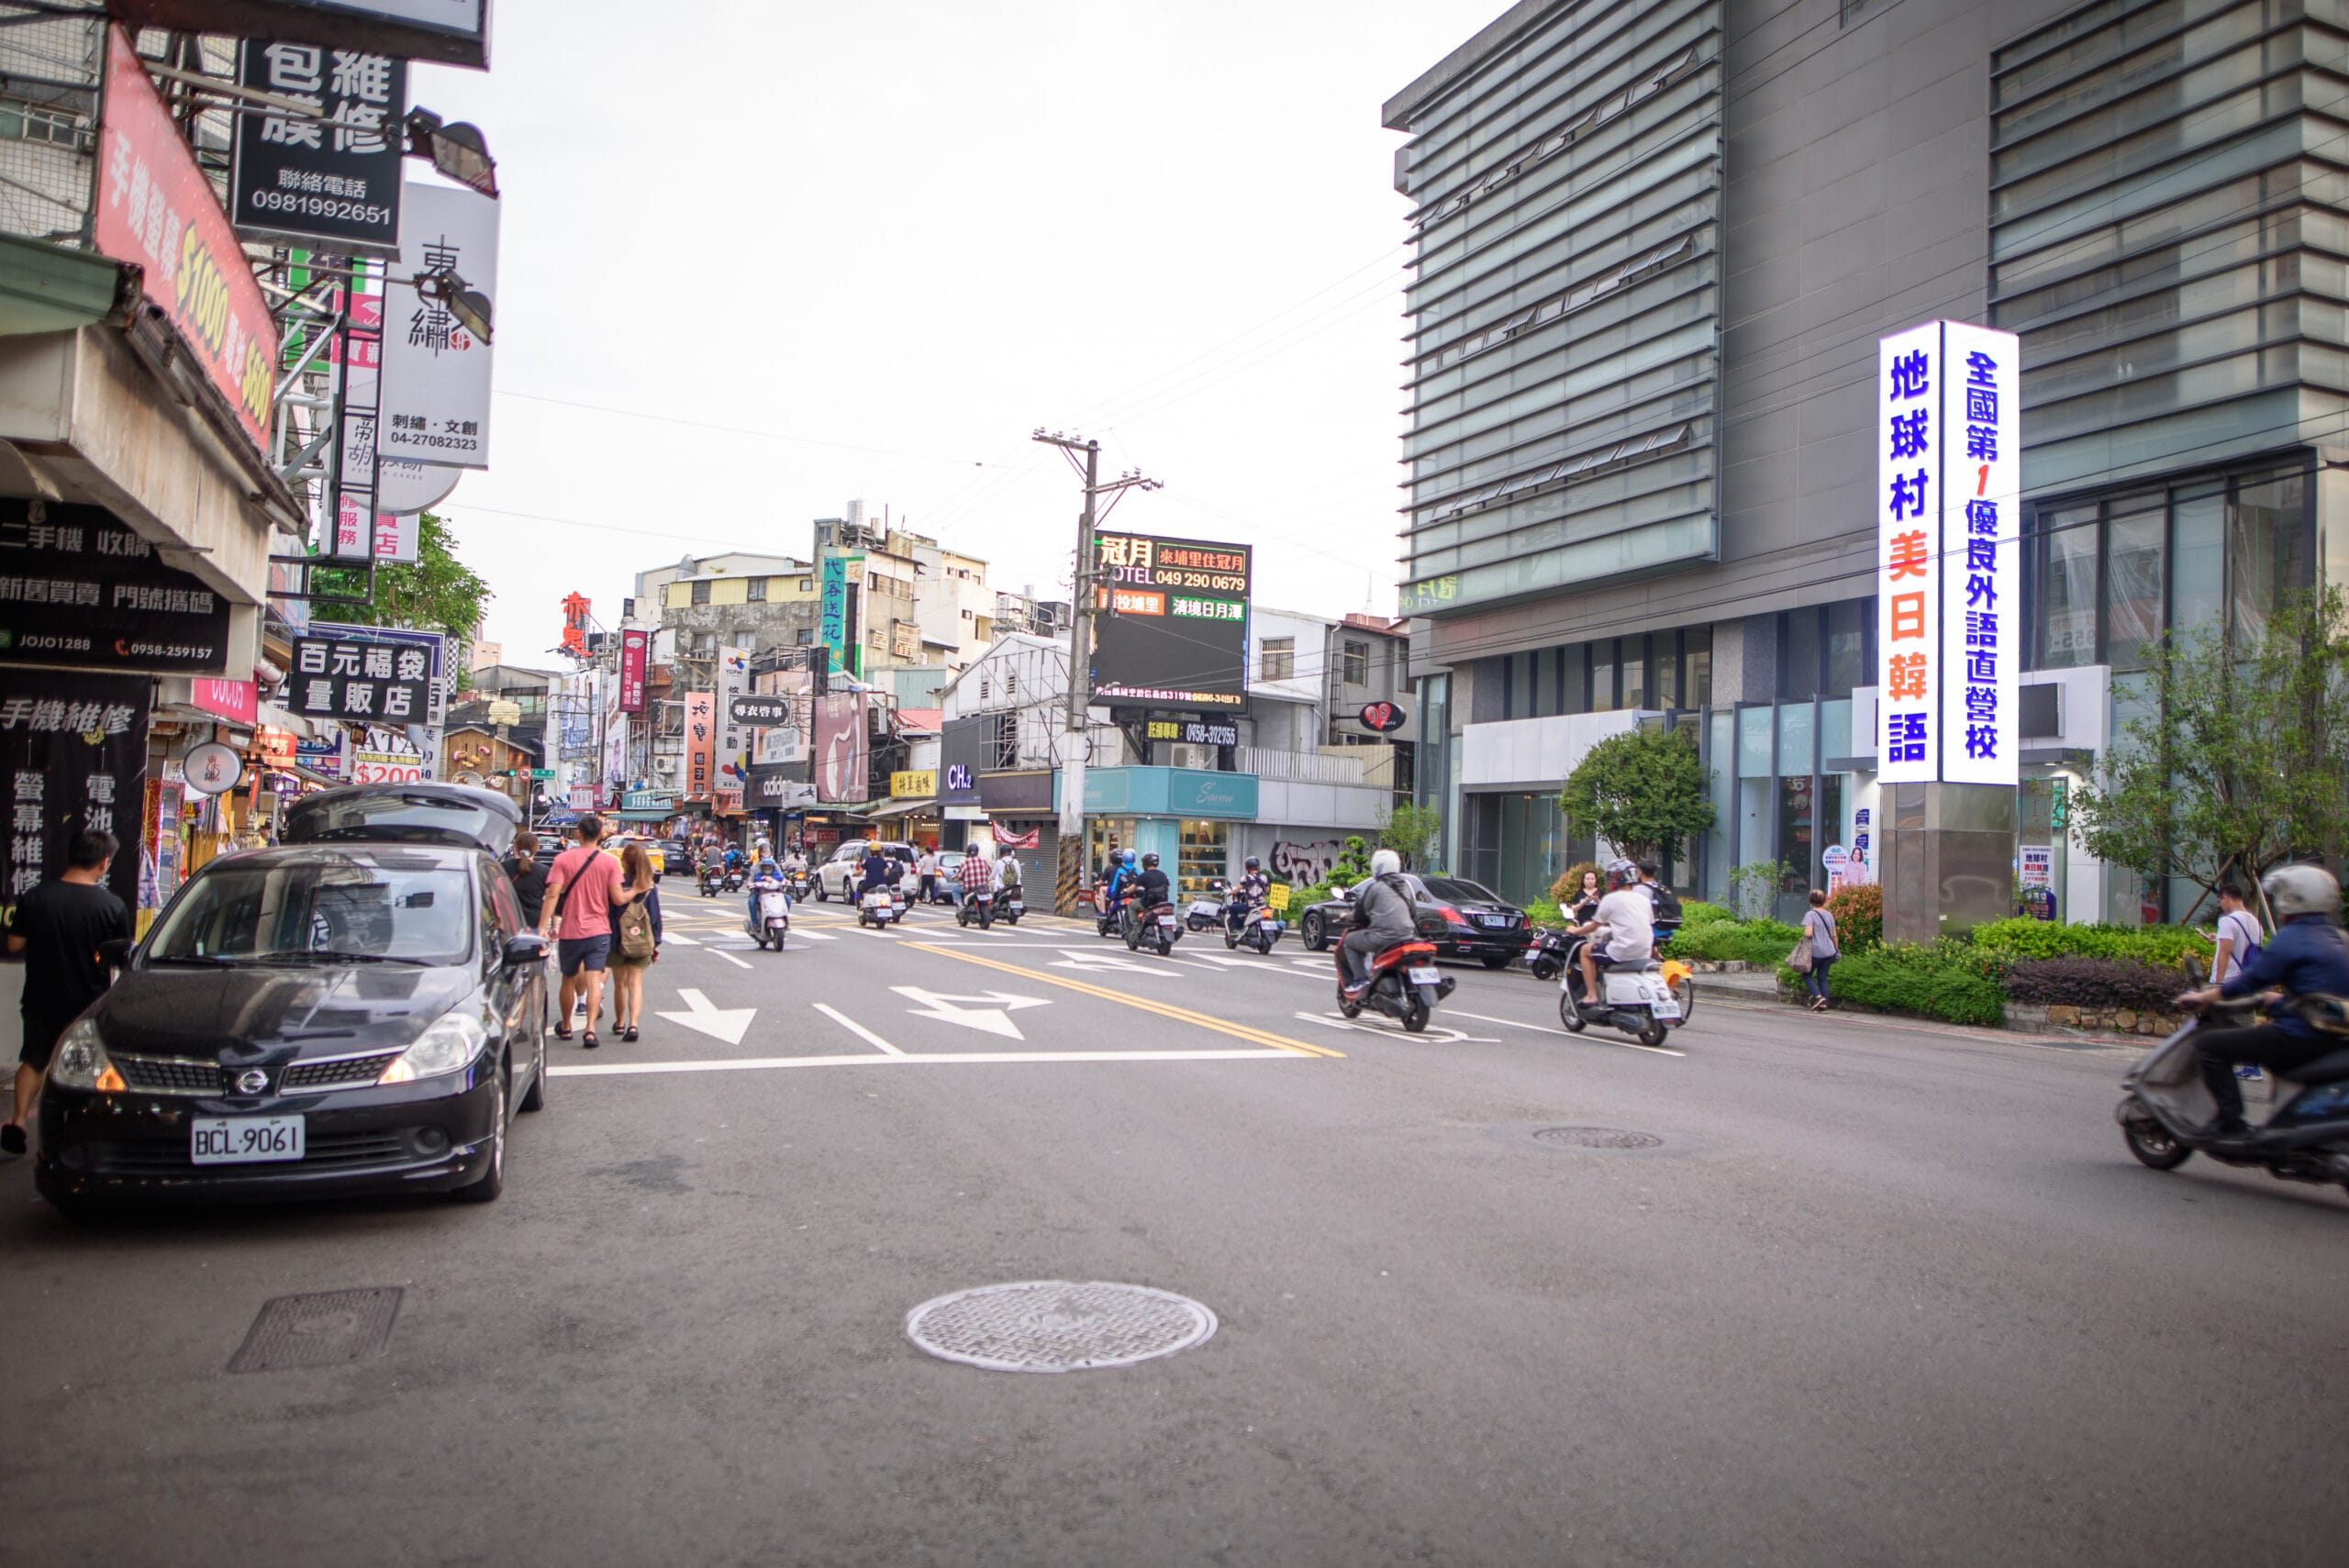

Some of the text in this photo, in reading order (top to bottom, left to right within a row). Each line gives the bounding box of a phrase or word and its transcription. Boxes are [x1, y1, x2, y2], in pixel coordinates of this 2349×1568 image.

[330, 50, 390, 153] 維修
[278, 169, 366, 199] 聯絡電話
[252, 190, 390, 225] 0981992651
[176, 220, 228, 361] $1000
[391, 431, 477, 451] 04-27082323
[1101, 536, 1153, 567] 冠月
[1888, 349, 1929, 763] 地球村美日韓語
[1965, 350, 1998, 760] 全國第1優良外語直營校
[1156, 570, 1246, 591] 049 290 0679
[823, 560, 842, 640] 代客送花
[19, 635, 213, 660] JOJO1288 0958-259157
[300, 642, 426, 682] 百元福袋
[0, 699, 135, 734] 手機維修
[305, 680, 412, 717] 量販店
[948, 764, 972, 791] CH.2
[11, 771, 44, 895] 螢幕維修
